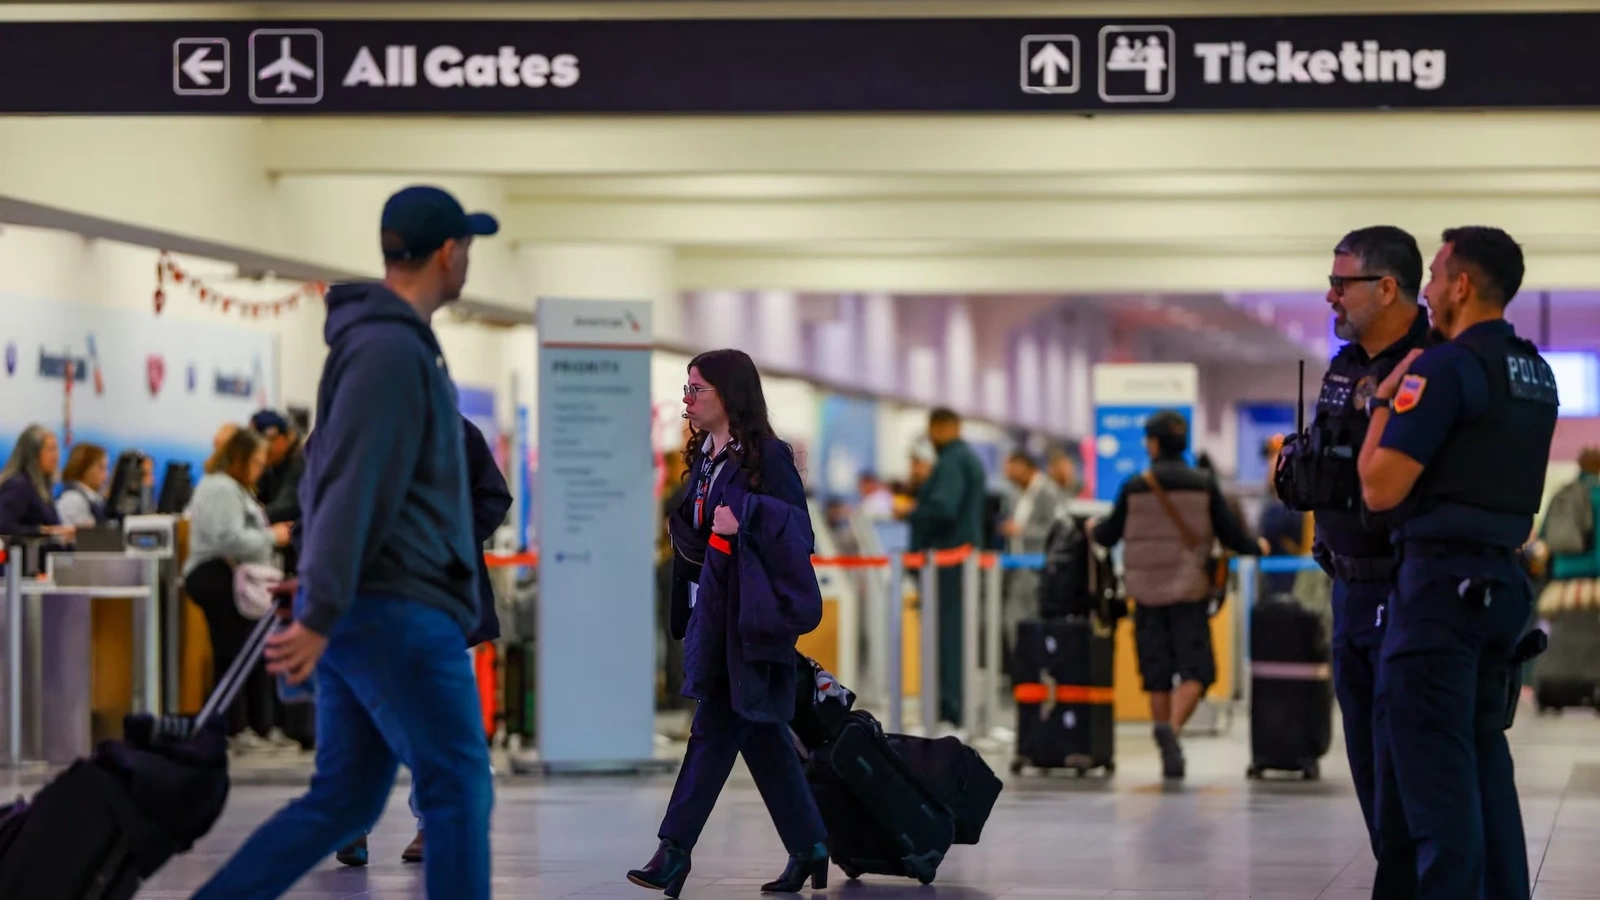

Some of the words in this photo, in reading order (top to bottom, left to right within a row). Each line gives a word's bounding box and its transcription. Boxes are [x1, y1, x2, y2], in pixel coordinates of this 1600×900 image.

[342, 45, 417, 87] All
[423, 45, 580, 88] Gates
[1194, 40, 1446, 89] Ticketing
